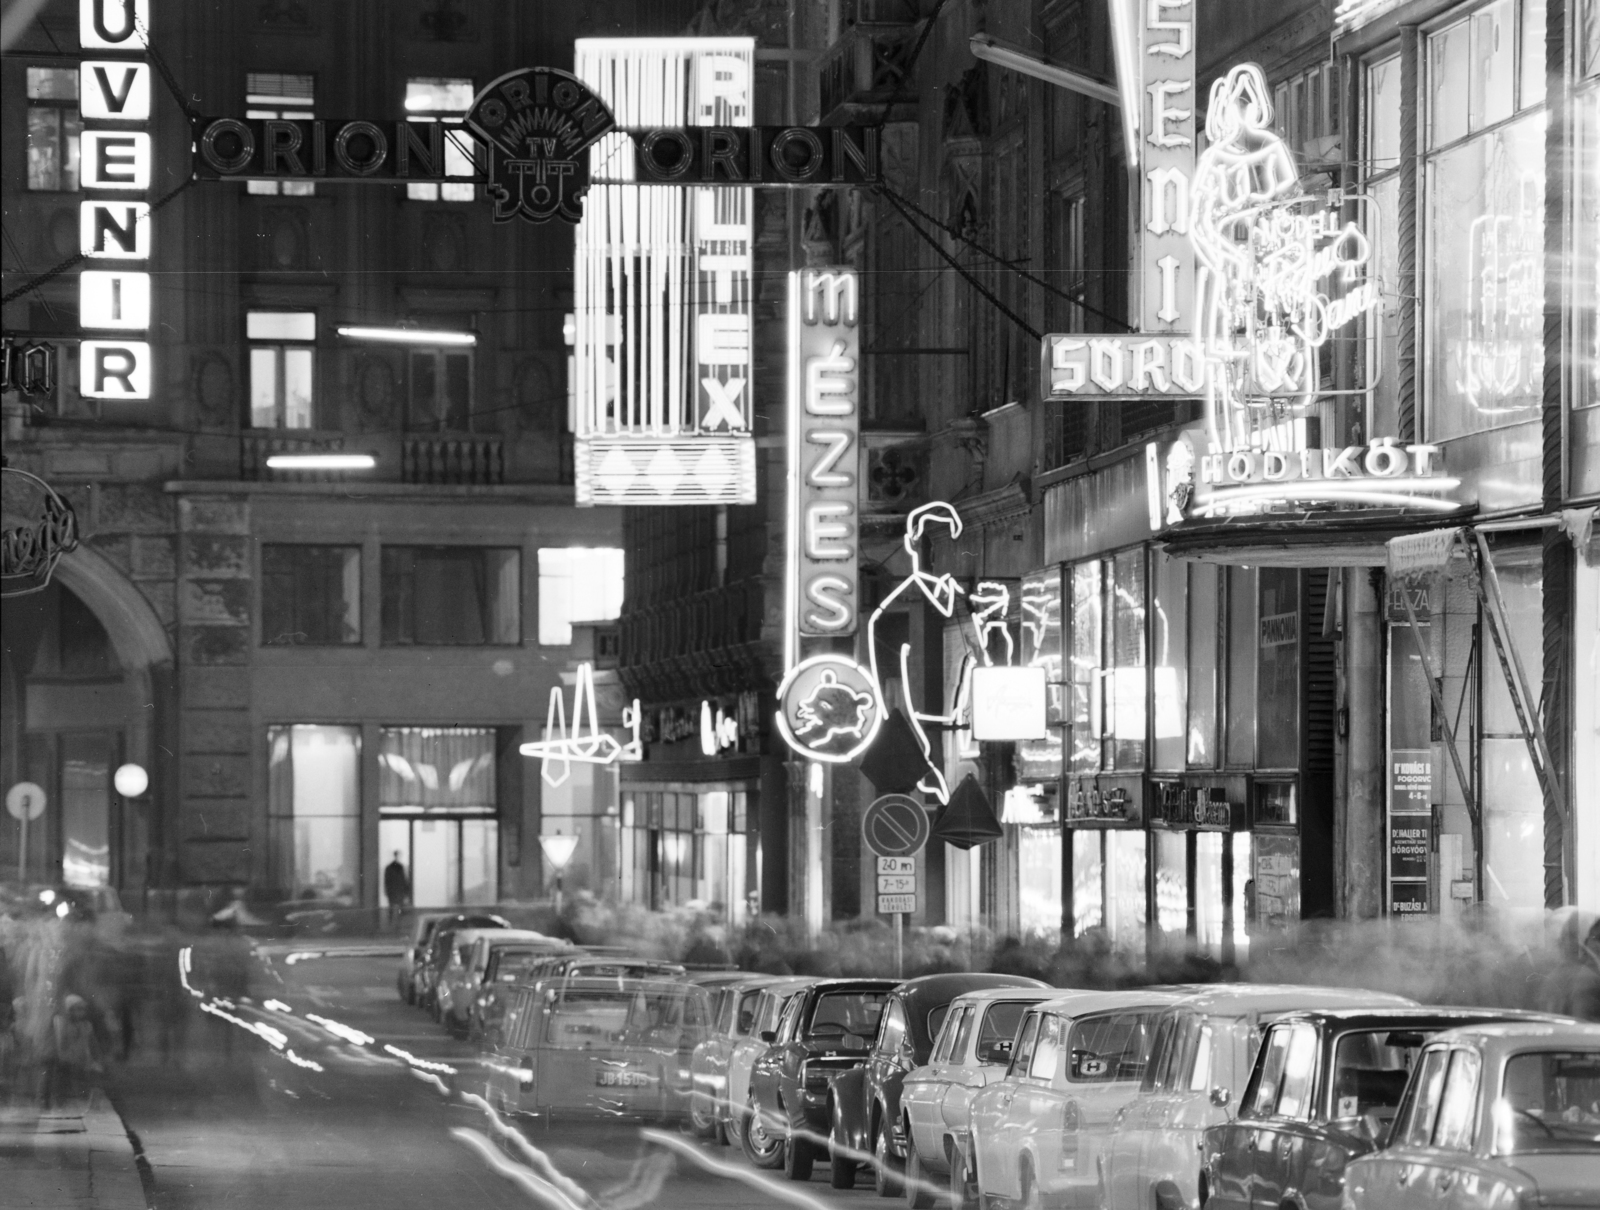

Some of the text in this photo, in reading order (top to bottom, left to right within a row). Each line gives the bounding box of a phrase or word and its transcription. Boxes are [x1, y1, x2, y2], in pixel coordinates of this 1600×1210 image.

[479, 75, 608, 136] ORION
[202, 118, 441, 176] ORION
[526, 137, 557, 158] TV
[641, 127, 877, 181] ORION
[700, 54, 749, 428] RLTEX
[882, 859, 912, 871] 20 m
[1086, 1063, 1100, 1072] H
